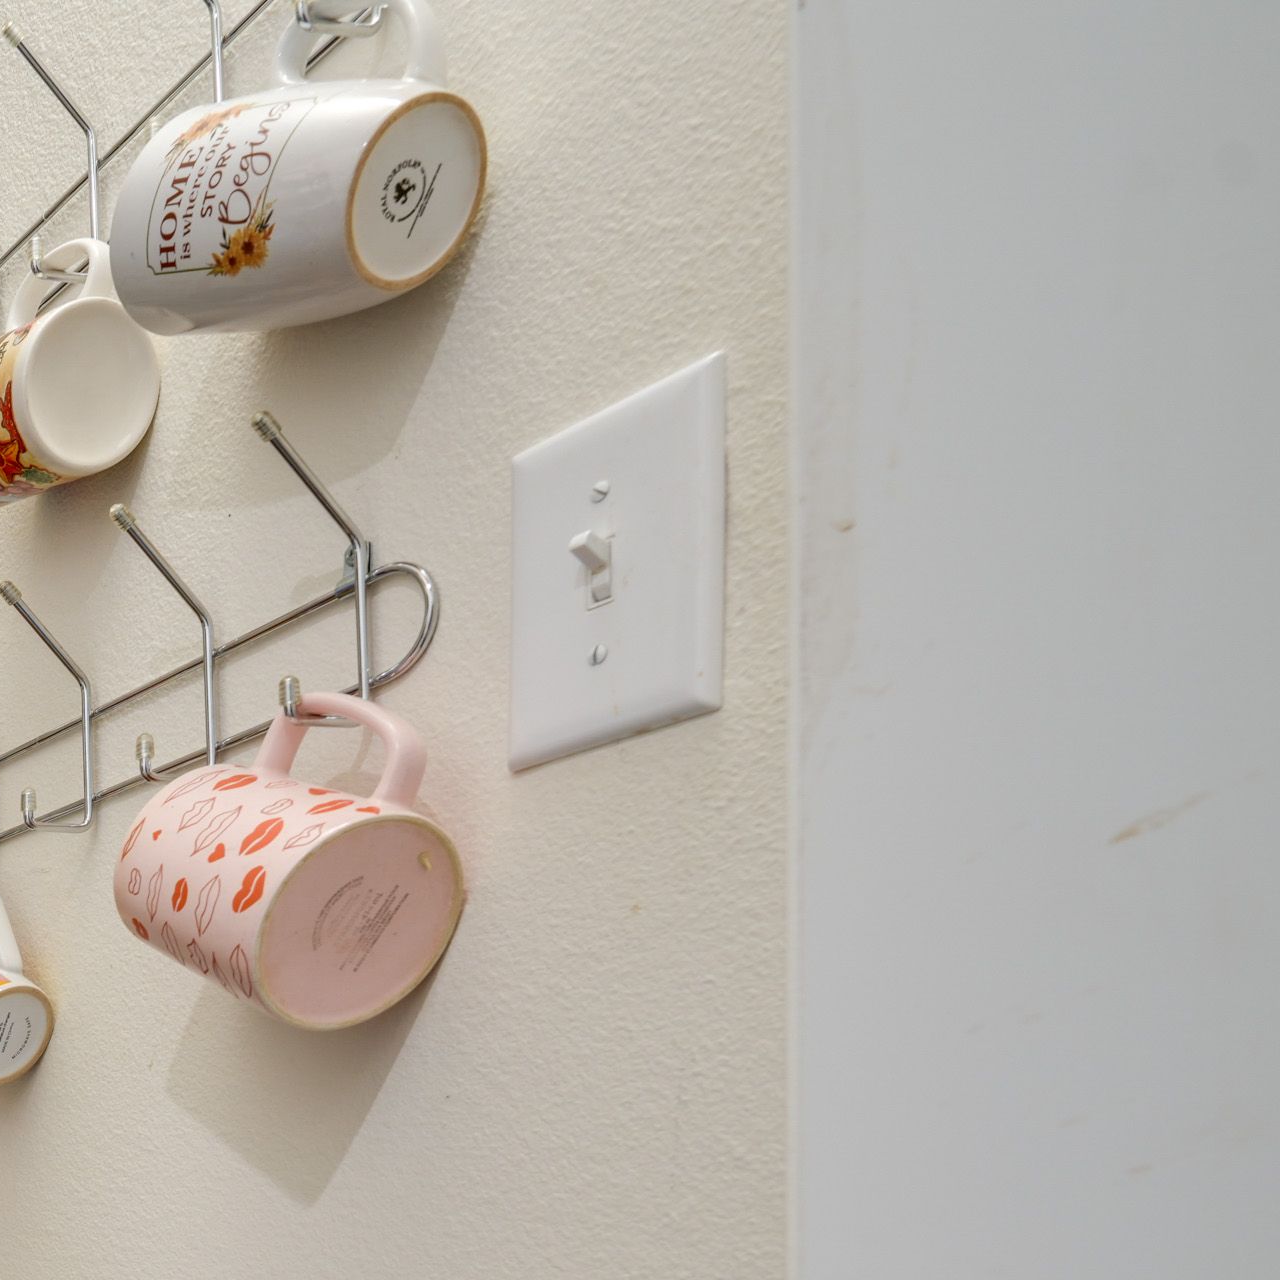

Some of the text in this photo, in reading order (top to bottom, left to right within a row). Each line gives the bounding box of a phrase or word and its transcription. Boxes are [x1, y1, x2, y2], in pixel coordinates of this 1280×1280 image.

[159, 146, 205, 271] HOME
[180, 126, 230, 260] is where our
[200, 142, 237, 219] STORY
[217, 101, 291, 225] Begins
[381, 193, 396, 223] ROYAL
